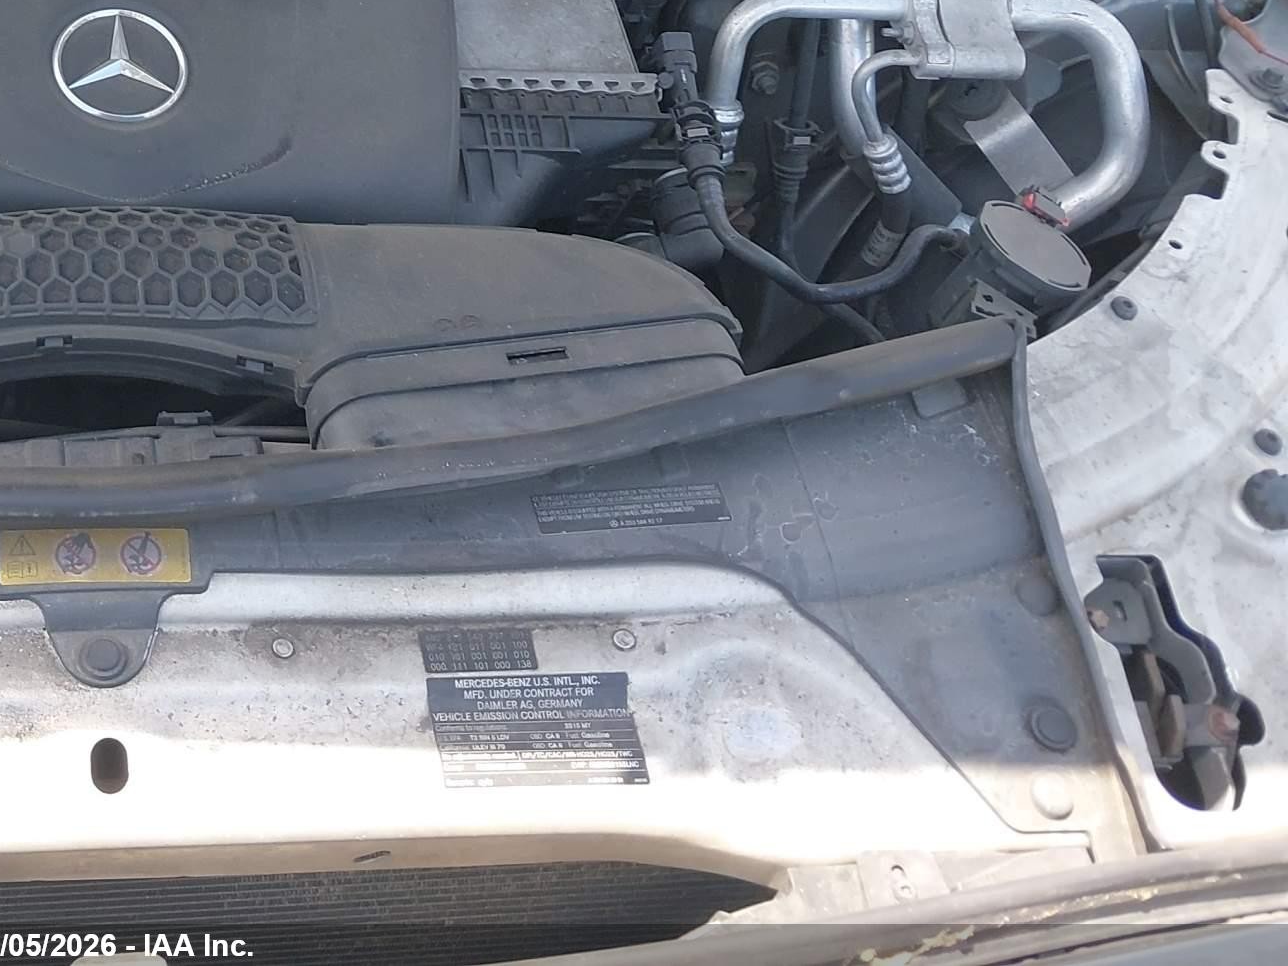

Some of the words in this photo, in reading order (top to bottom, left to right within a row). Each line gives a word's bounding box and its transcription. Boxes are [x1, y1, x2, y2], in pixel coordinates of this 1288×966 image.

[512, 641, 528, 649] 100
[513, 650, 530, 658] 010
[430, 663, 448, 671] 000
[453, 662, 468, 670] 111
[474, 662, 489, 670] 101
[494, 661, 511, 669] 000
[517, 660, 532, 668] 138
[455, 678, 532, 689] MERCEDES-BENZ
[533, 677, 552, 687] U.S.
[554, 676, 580, 687] INTL.,
[581, 675, 601, 685] INC.
[464, 689, 487, 699] MFD.
[489, 689, 522, 698] UNDER
[523, 687, 574, 698] CONTRACT
[575, 687, 594, 696] FOR
[477, 700, 518, 710] DAIMLER
[538, 698, 584, 709] GERMANY
[432, 712, 471, 722] VEHICLE
[474, 711, 519, 721] EMISSION
[520, 710, 565, 720] CONTROL
[566, 707, 632, 719] INFORMATION
